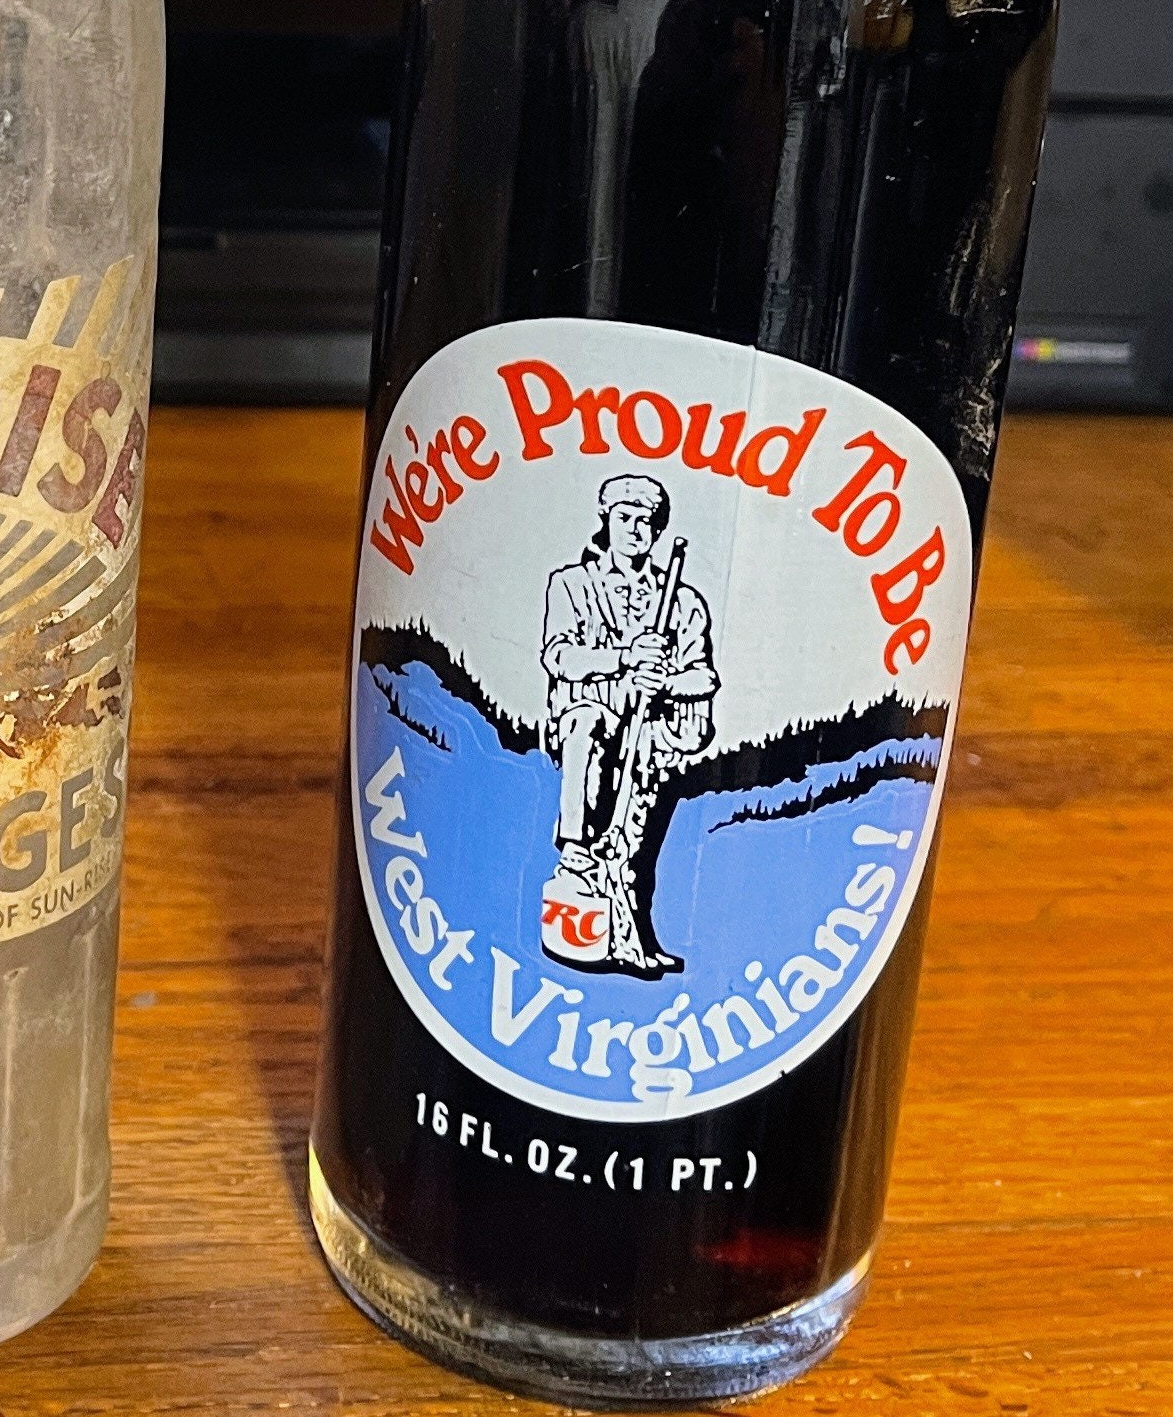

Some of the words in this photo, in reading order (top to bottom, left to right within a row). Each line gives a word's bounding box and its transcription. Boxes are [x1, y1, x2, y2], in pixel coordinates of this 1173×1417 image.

[368, 412, 500, 577] We're
[497, 358, 828, 498] Proud
[811, 430, 907, 558] To
[871, 524, 946, 676] Be
[363, 746, 476, 992] West
[489, 822, 912, 1103] Virginians!
[540, 898, 608, 948] RC
